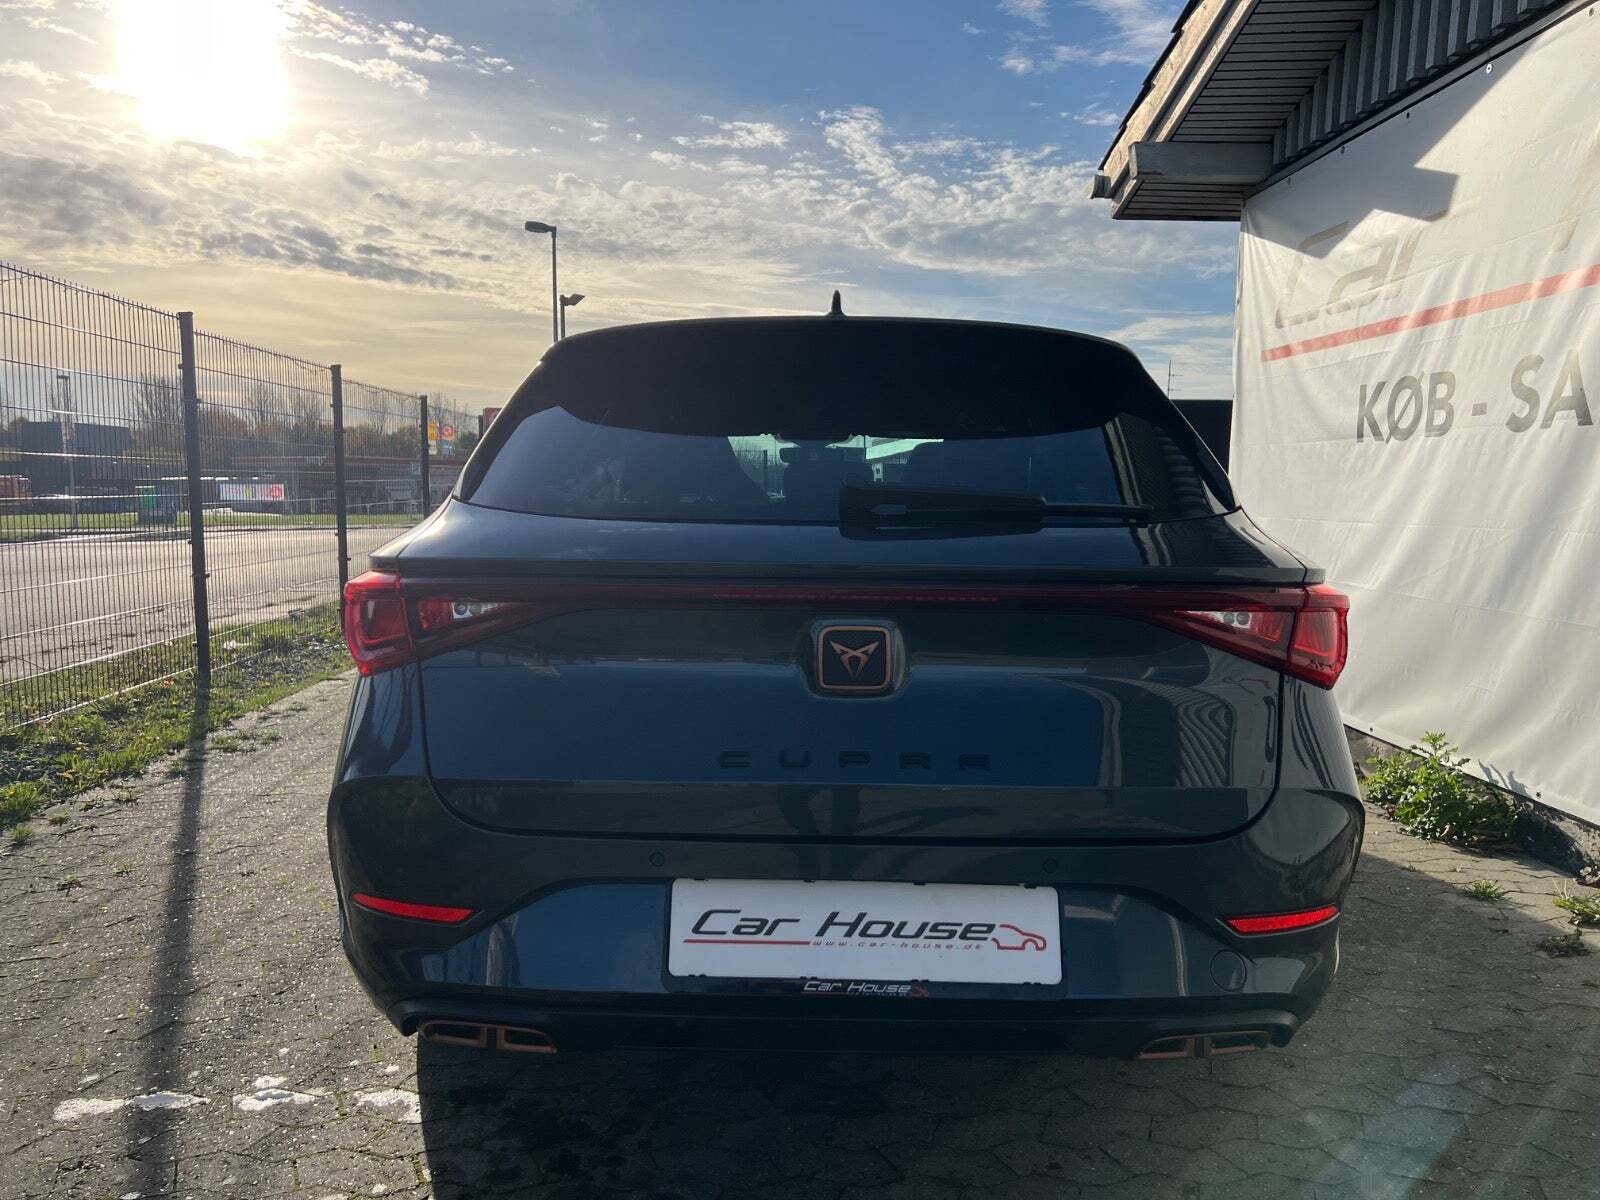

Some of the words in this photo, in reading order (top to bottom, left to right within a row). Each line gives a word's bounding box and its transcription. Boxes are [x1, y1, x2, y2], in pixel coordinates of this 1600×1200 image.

[1356, 371, 1456, 443] KØB
[720, 752, 990, 770] CUPRA
[691, 909, 800, 936] Car
[815, 911, 996, 941] House
[812, 940, 984, 950] www.car-house.dk
[803, 981, 842, 991] Car
[847, 982, 911, 993] House
